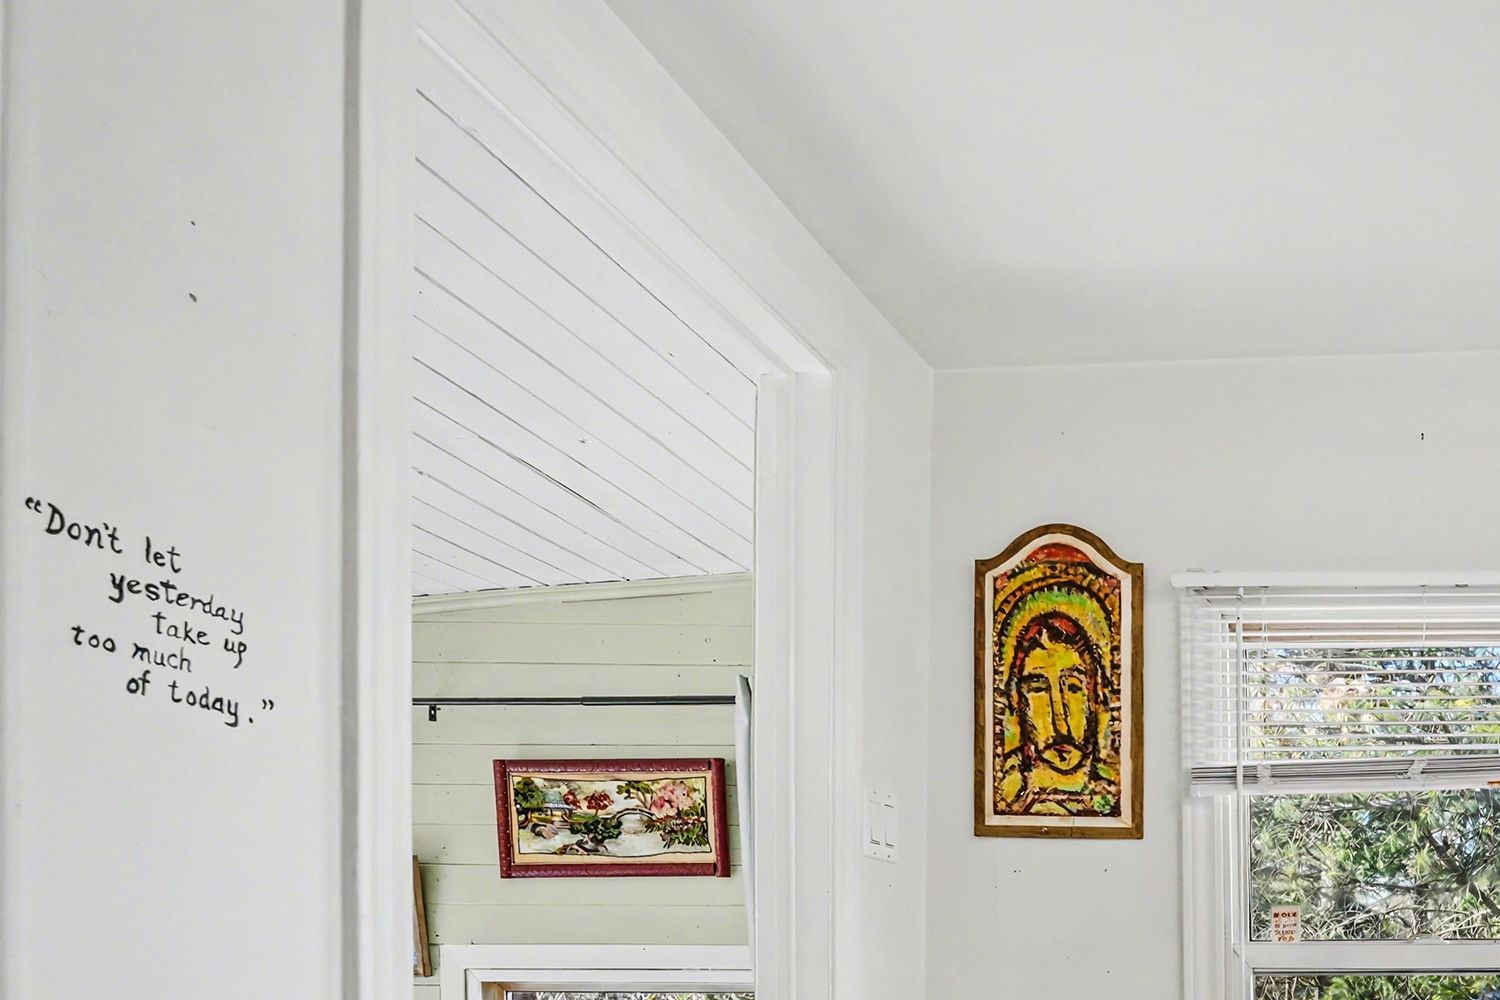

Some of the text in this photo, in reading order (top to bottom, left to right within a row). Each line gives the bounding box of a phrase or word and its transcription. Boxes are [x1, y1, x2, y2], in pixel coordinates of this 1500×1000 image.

[25, 497, 181, 573] "Don't let
[108, 573, 244, 635] yesterday
[71, 625, 192, 672] too much
[152, 611, 247, 669] take up
[126, 670, 150, 696] of
